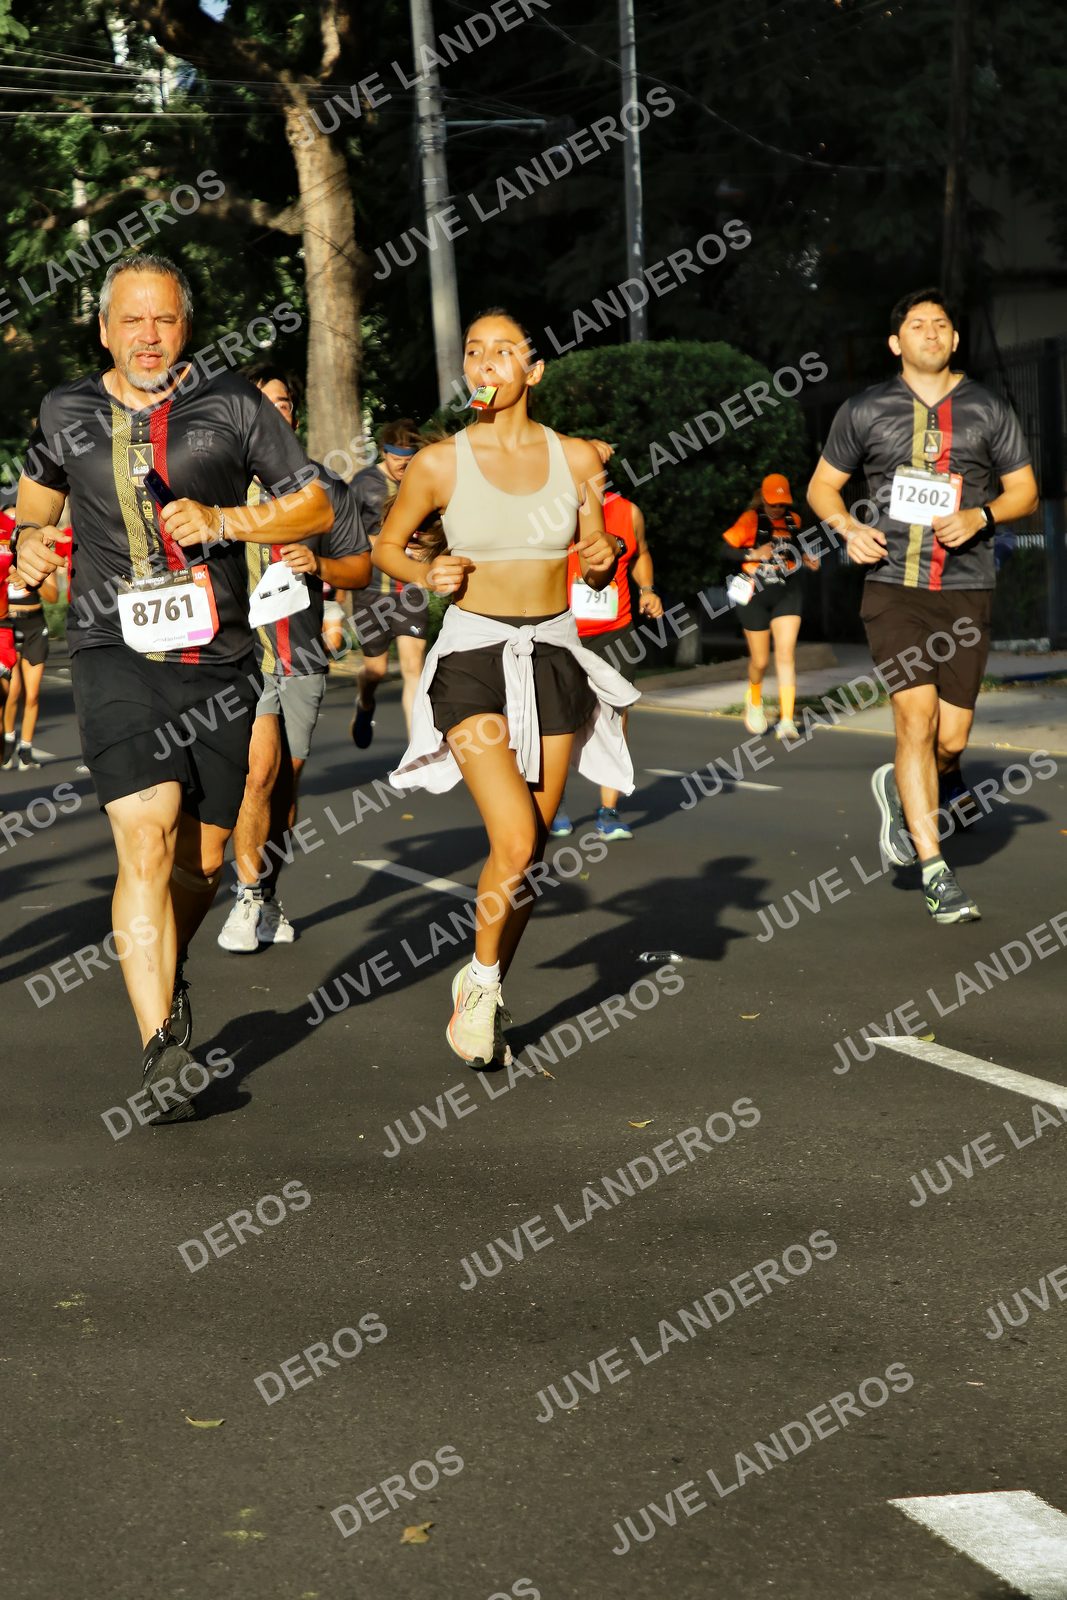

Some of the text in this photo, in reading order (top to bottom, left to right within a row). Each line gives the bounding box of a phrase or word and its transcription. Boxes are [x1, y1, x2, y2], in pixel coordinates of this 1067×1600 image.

[897, 485, 950, 508] 12602
[586, 591, 608, 604] 791
[132, 593, 193, 626] 8761
